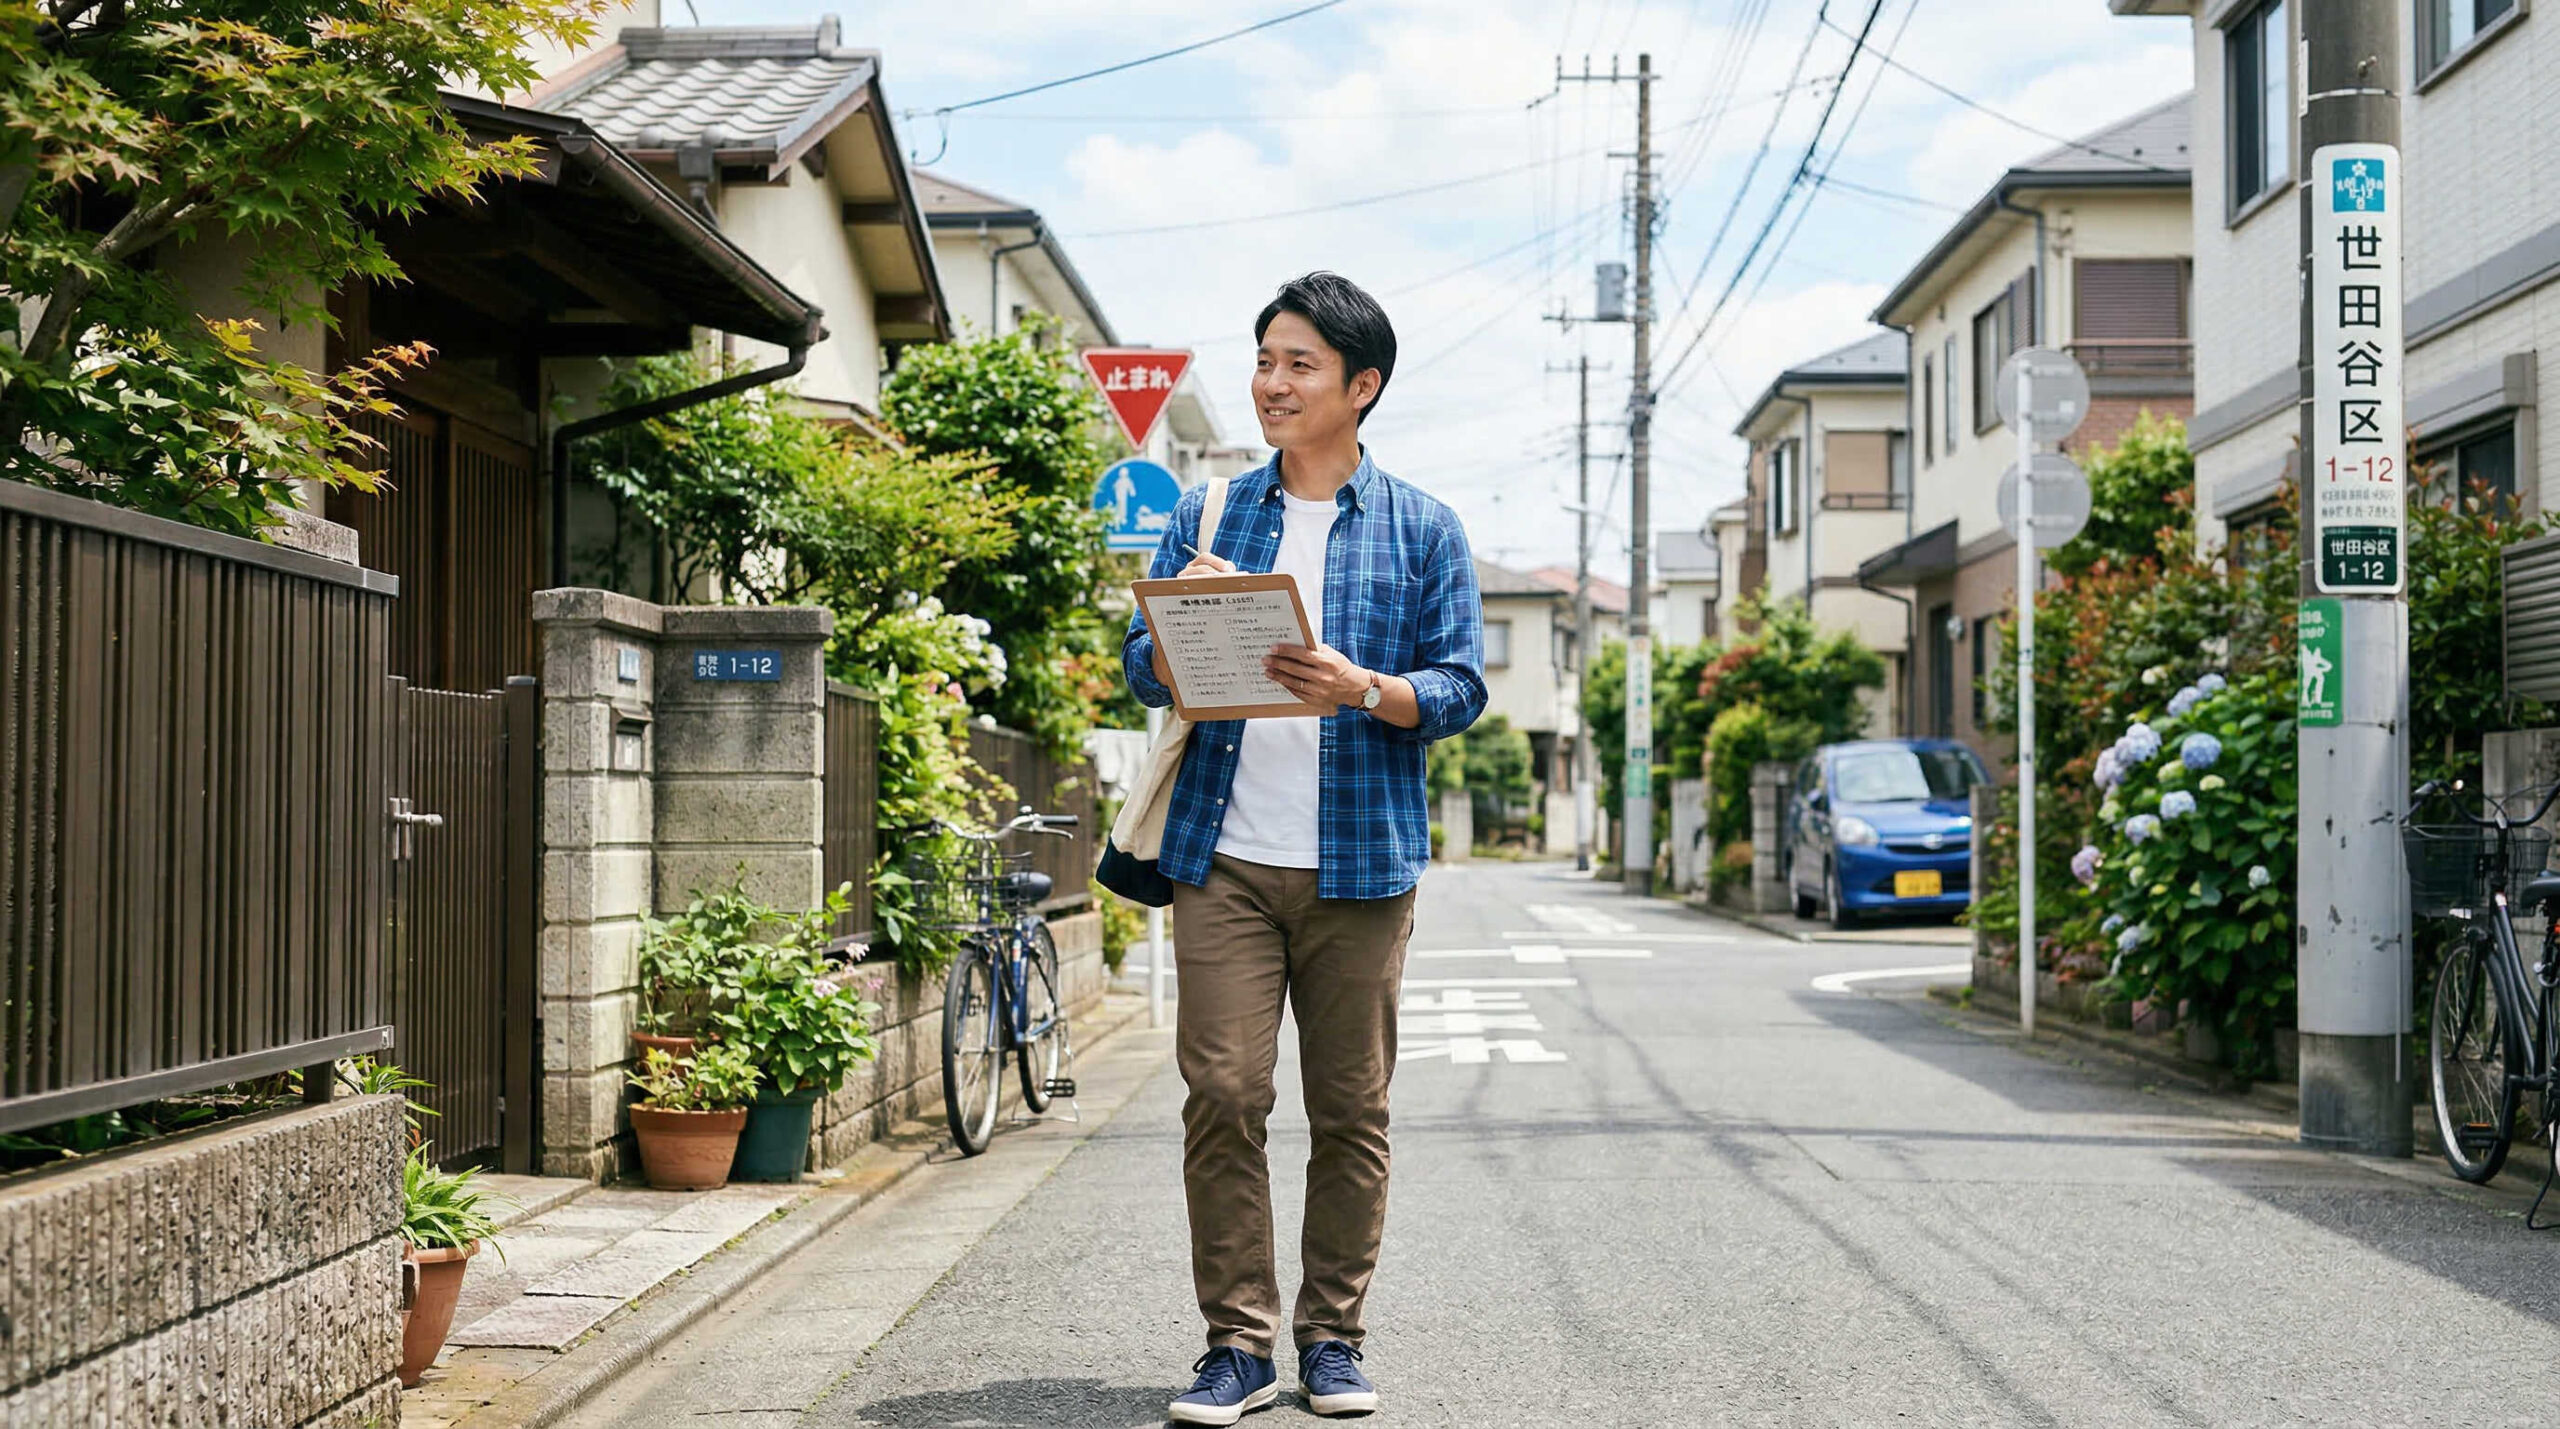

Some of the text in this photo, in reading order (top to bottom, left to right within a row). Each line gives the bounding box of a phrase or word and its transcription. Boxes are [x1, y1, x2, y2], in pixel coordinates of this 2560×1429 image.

[2336, 225, 2383, 445] 世田谷区
[1105, 366, 1173, 391] 止まれ
[2325, 455, 2393, 482] 1-12
[2331, 539, 2391, 556] 世田谷区
[2338, 561, 2384, 580] 1-12
[731, 657, 772, 674] 1-12
